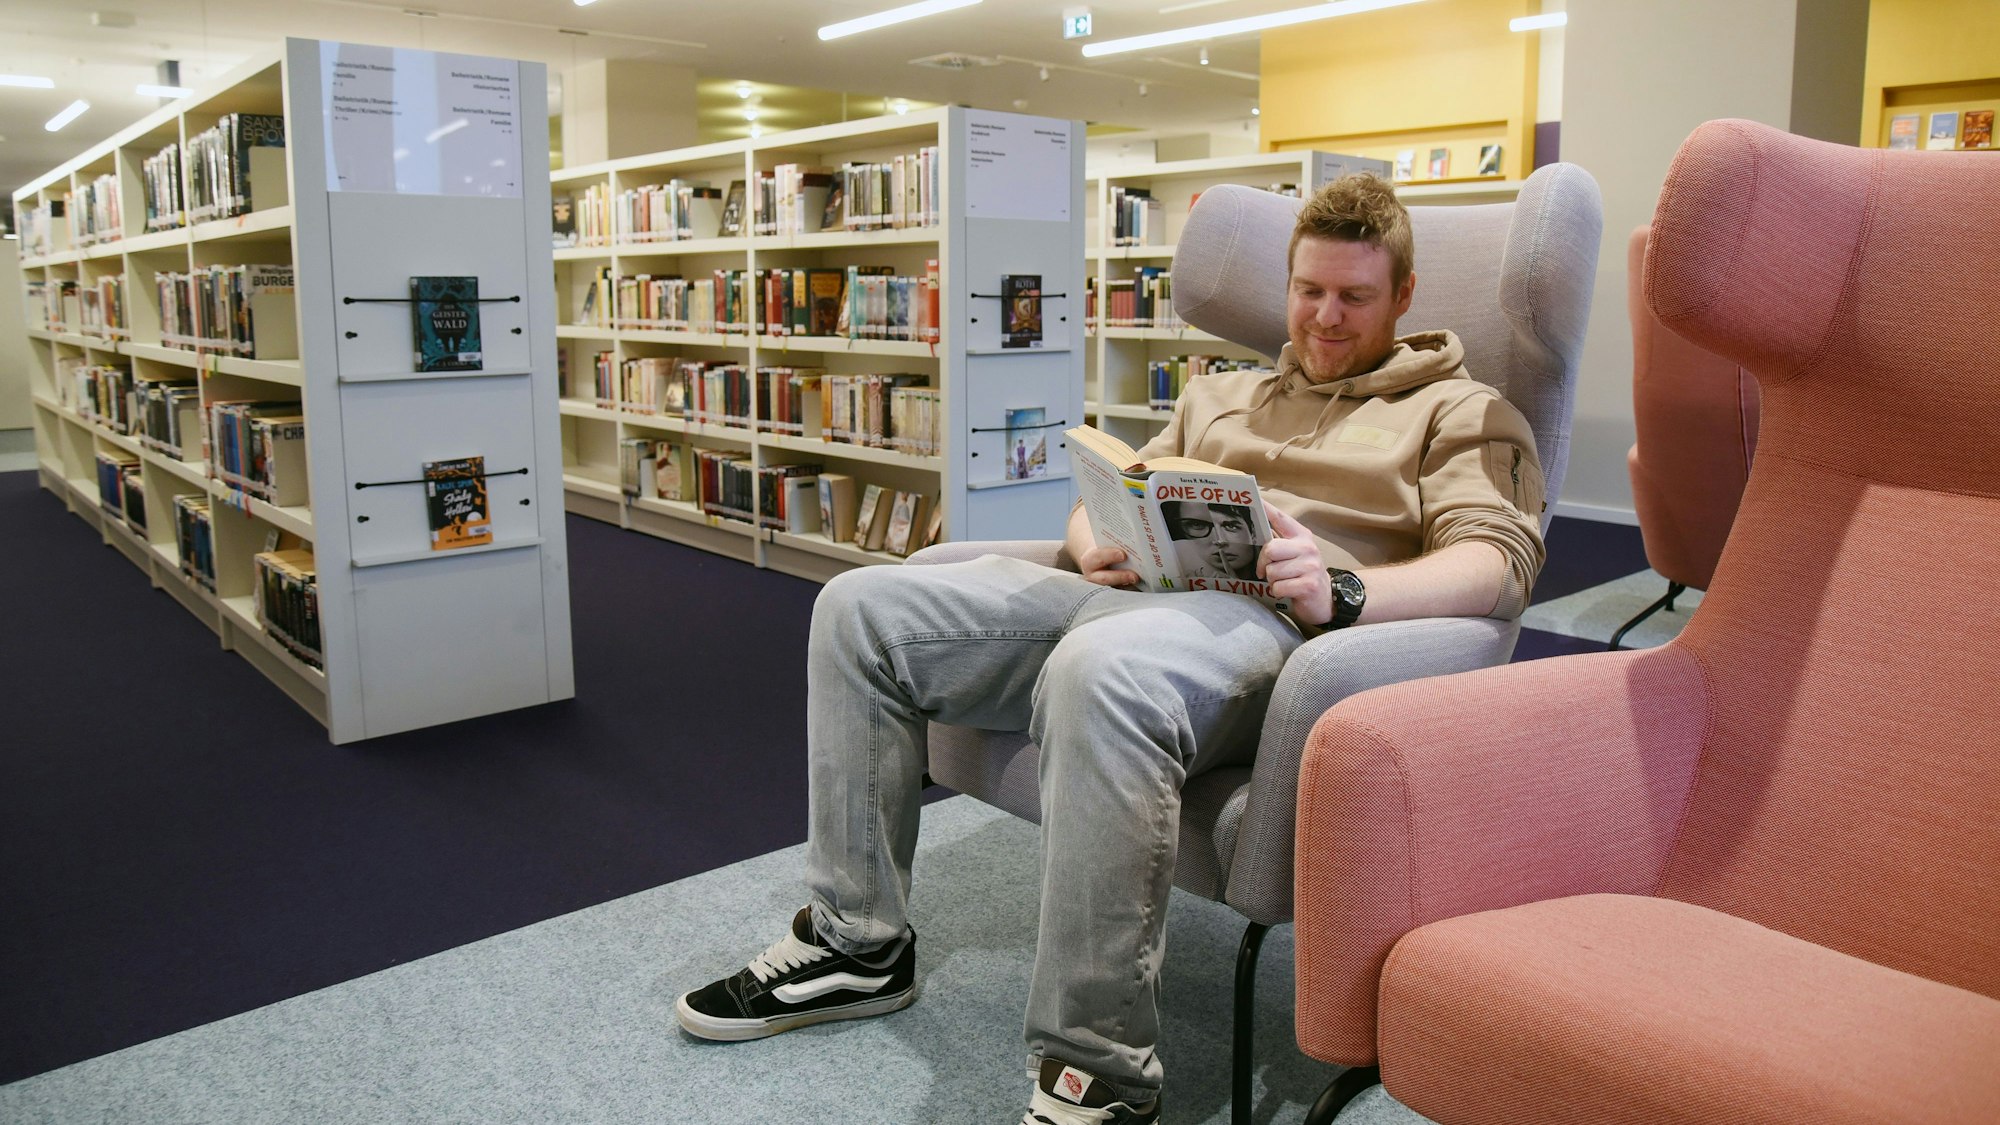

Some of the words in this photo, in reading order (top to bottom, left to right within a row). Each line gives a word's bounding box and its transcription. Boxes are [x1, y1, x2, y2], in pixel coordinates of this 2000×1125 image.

[252, 276, 294, 287] BURGE
[432, 311, 467, 319] GEISTER
[433, 320, 467, 329] WALD
[444, 489, 472, 505] Shady
[1156, 485, 1197, 500] ONE
[1200, 487, 1224, 503] OF
[1228, 490, 1253, 505] US
[444, 502, 473, 519] Hollow
[1137, 504, 1150, 526] LYING
[1146, 533, 1156, 544] US
[1149, 543, 1159, 553] OF
[1153, 553, 1164, 568] ONE
[1188, 578, 1208, 592] IS
